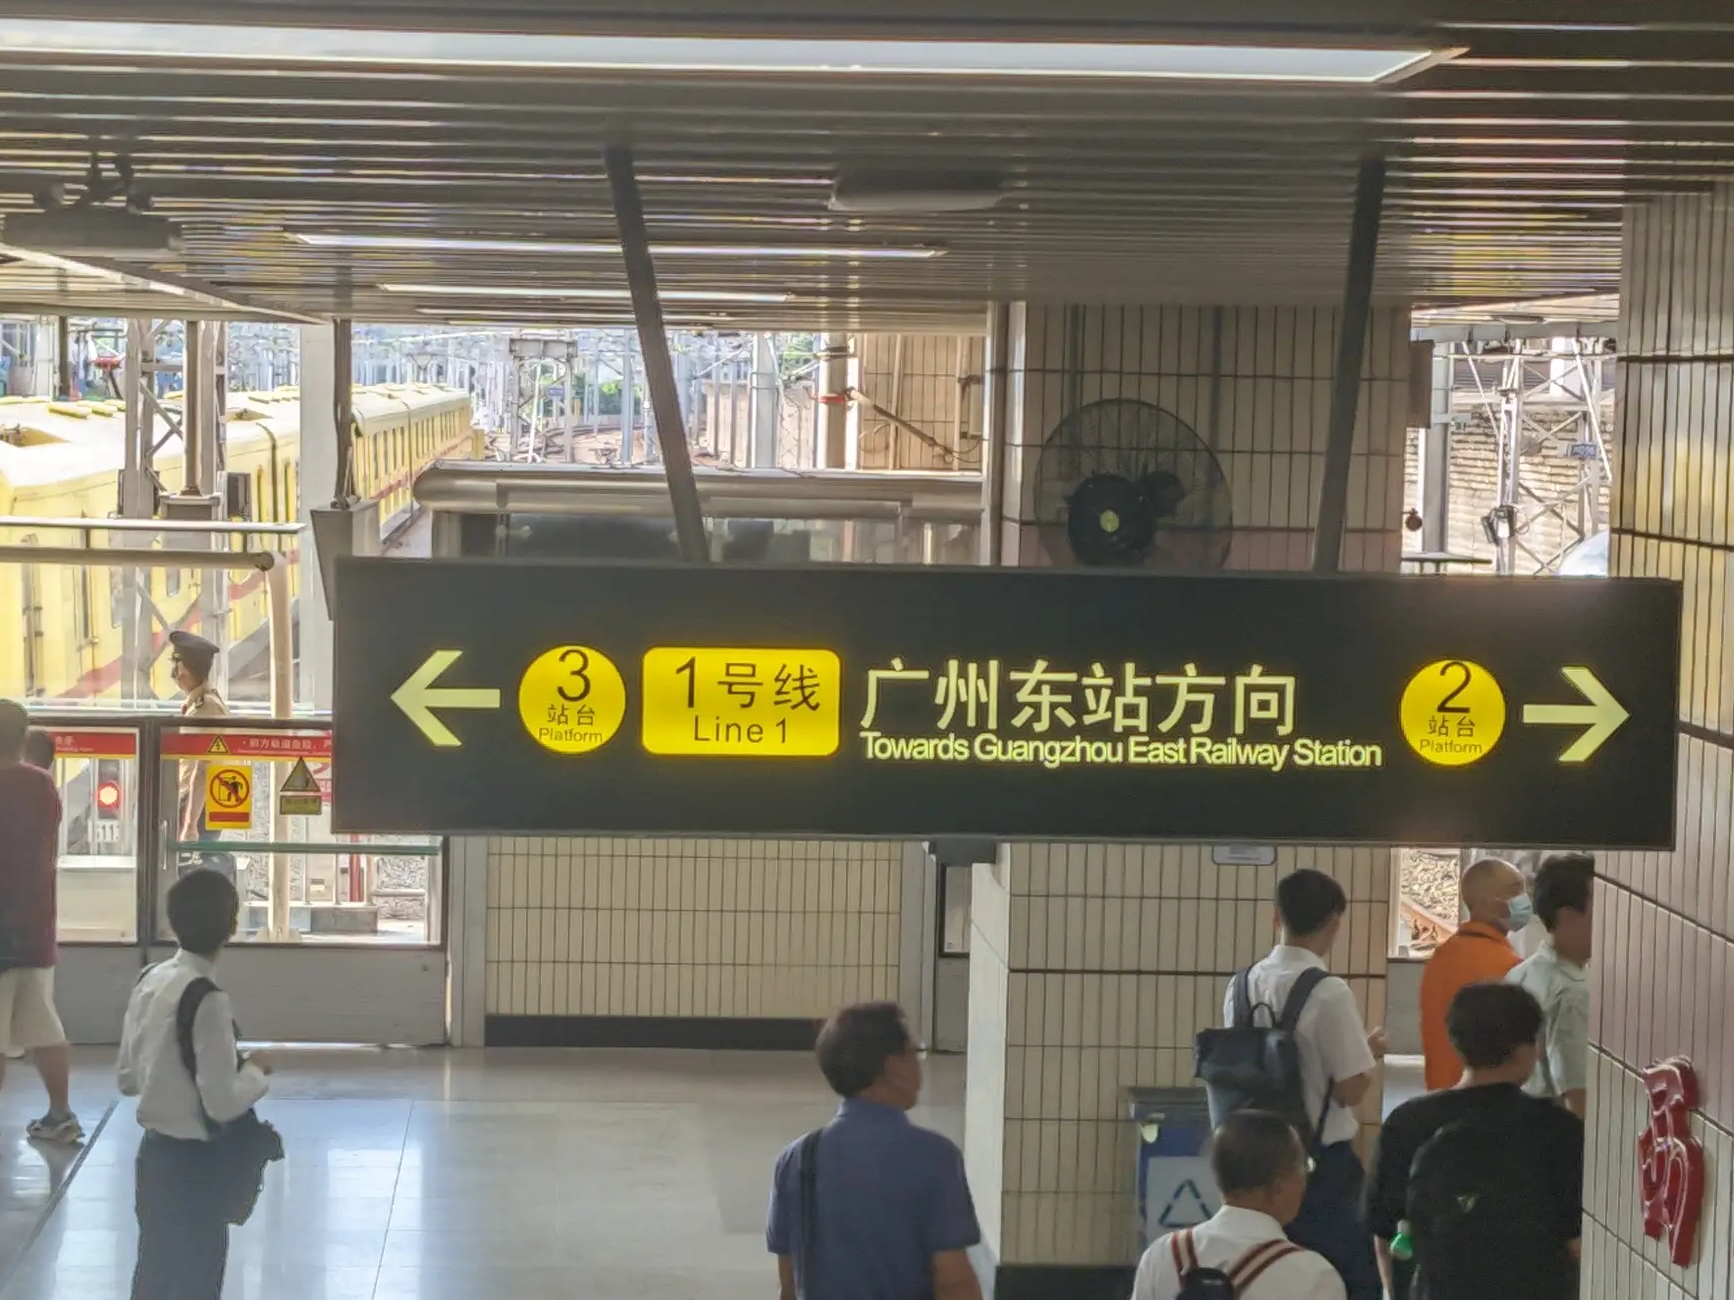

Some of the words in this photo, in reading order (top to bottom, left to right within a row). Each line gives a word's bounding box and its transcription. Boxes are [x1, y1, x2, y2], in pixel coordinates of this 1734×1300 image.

[557, 648, 591, 703] 3
[675, 655, 822, 712] 1号线
[1435, 661, 1474, 715] 2
[546, 702, 597, 727] 站台
[860, 659, 1295, 736] 广州东站方向
[538, 727, 604, 743] Platform
[693, 714, 765, 744] Line
[774, 718, 788, 744] 1
[1427, 714, 1479, 739] 站台
[861, 733, 969, 761] Towards
[974, 733, 1125, 768] Guangzhou
[1128, 735, 1186, 763] East
[1188, 736, 1289, 772] Railway
[1293, 738, 1382, 767] Station
[1418, 738, 1484, 756] Platform
